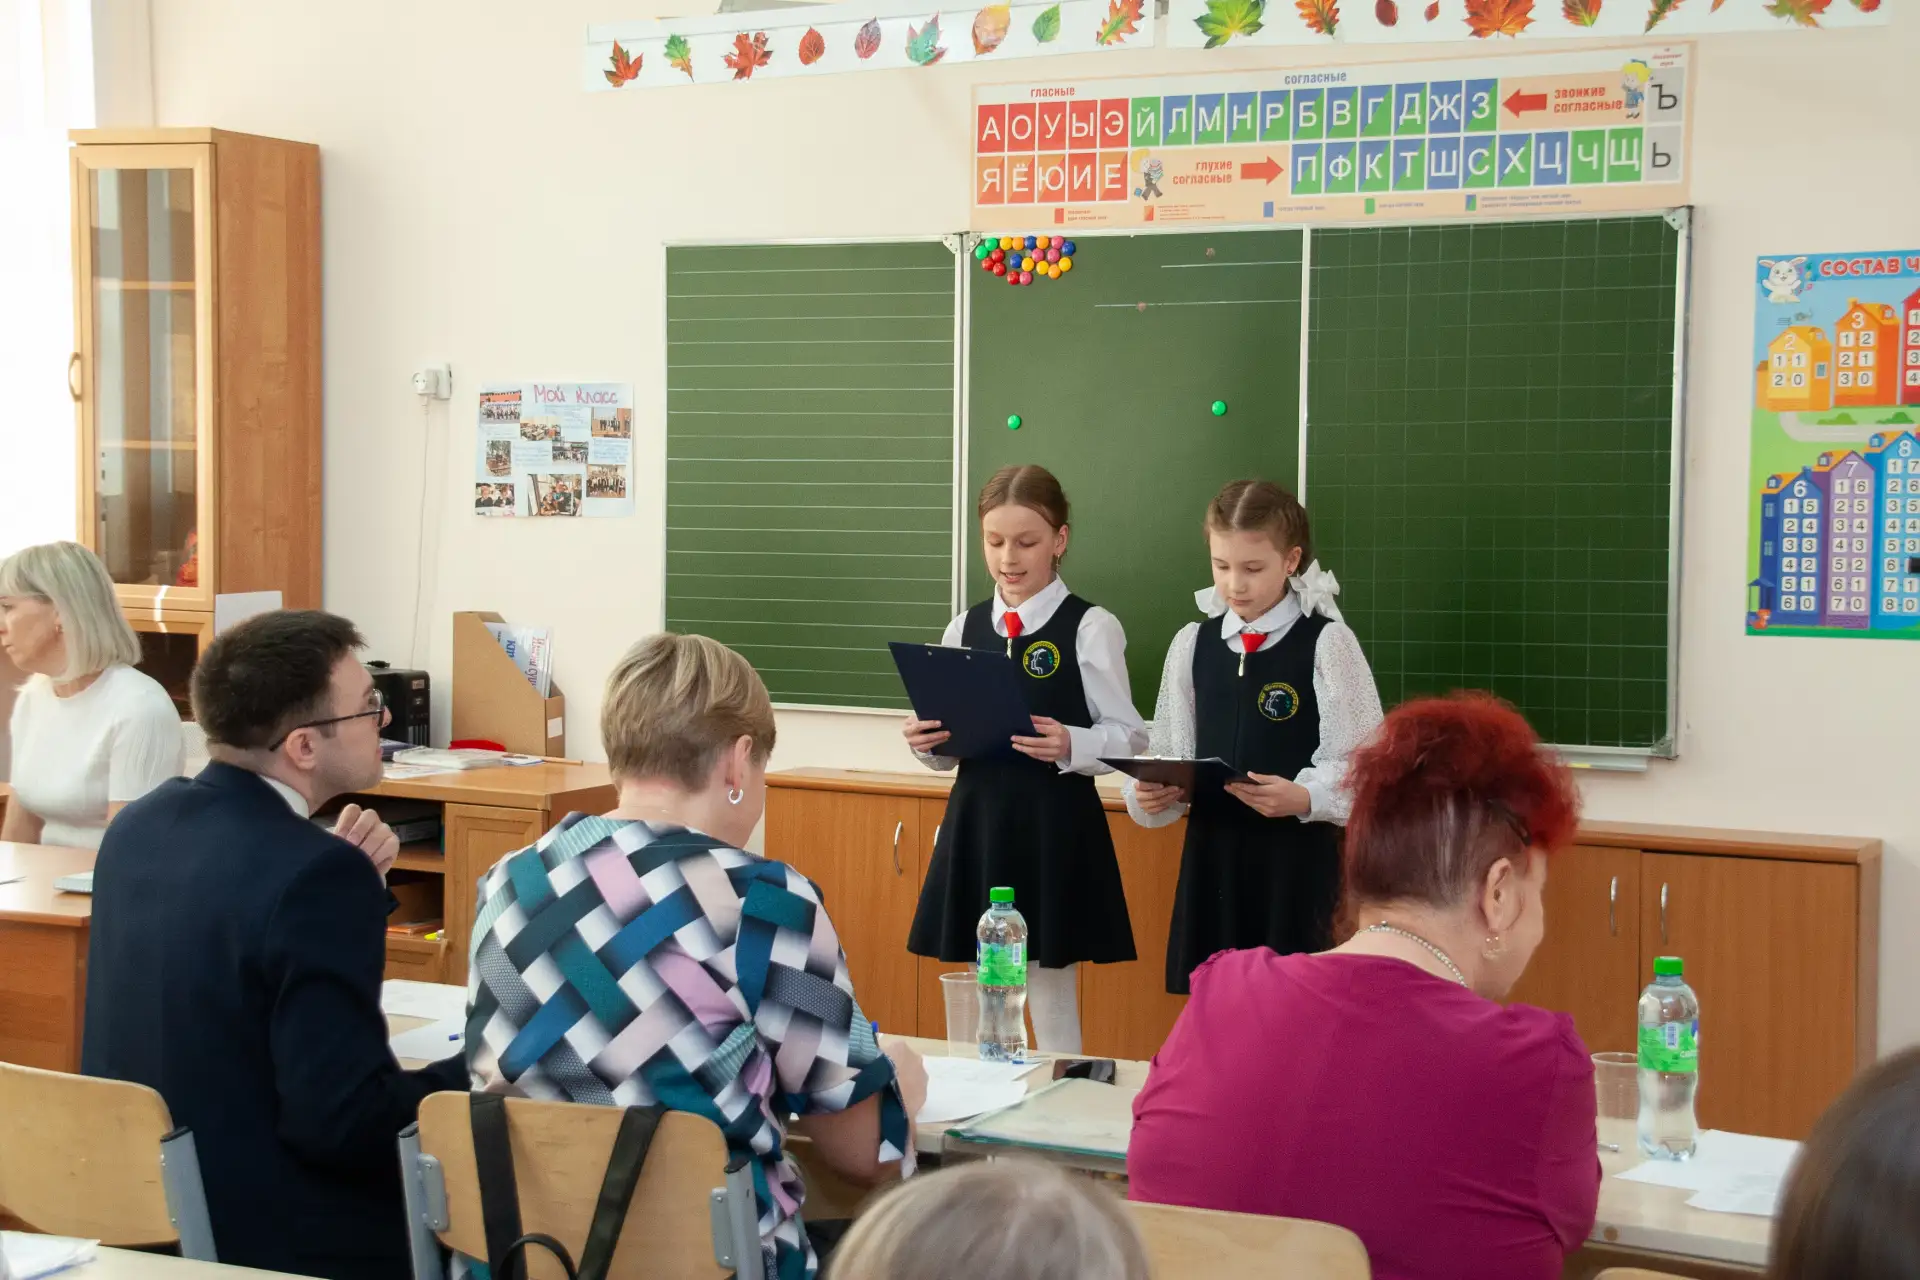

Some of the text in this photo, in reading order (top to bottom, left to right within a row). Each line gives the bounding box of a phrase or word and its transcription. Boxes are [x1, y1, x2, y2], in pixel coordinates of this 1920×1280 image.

[1284, 71, 1347, 85] согласные
[1030, 87, 1075, 98] гласные
[1554, 86, 1606, 98] звонкие
[1652, 84, 1677, 109] Ъ
[1554, 100, 1623, 113] согласные
[982, 92, 1489, 140] А О У Ы Э Й Л М Н Р Б В Г Д Ж З
[1298, 139, 1639, 181] П Ф К Т Ш С Х Ц Ч Щ
[1652, 142, 1671, 167] Ь
[1196, 159, 1232, 171] глухие
[982, 164, 1121, 192] Я Ё Ю И Е
[1173, 173, 1232, 185] согласные
[1820, 258, 1900, 276] СОСТАВ
[1851, 312, 1864, 328] 3
[1784, 334, 1795, 350] 2
[1844, 333, 1872, 345] 1 2
[1776, 356, 1801, 367] 1 1
[1841, 354, 1869, 366] 2 1
[1775, 374, 1803, 386] 2 0
[1841, 373, 1870, 385] 3 0
[533, 383, 566, 404] Мой
[1898, 440, 1912, 456] 8
[1846, 461, 1858, 477] 7
[1891, 461, 1920, 472] 1 7
[1793, 480, 1808, 497] 6
[1838, 481, 1866, 493] 1 6
[1890, 481, 1919, 493] 2 6
[1788, 501, 1815, 512] 1 5
[1836, 500, 1866, 512] 2 5
[1889, 500, 1918, 512] 3 5
[1787, 520, 1814, 532] 2 4
[1836, 520, 1865, 532] 3 4
[1888, 521, 1917, 532] 4 4
[1786, 540, 1814, 552] 3 3
[1836, 540, 1864, 552] 4 3
[1888, 540, 1917, 552] 5 3
[1786, 560, 1813, 571] 4 2
[1835, 559, 1864, 571] 5 2
[1888, 560, 1896, 571] 6
[1785, 579, 1811, 590] 5 1
[1834, 579, 1861, 591] 6 1
[1888, 580, 1913, 591] 7 1
[1784, 598, 1812, 610] 6 0
[1834, 598, 1863, 610] 7 0
[1886, 599, 1915, 611] 8 0
